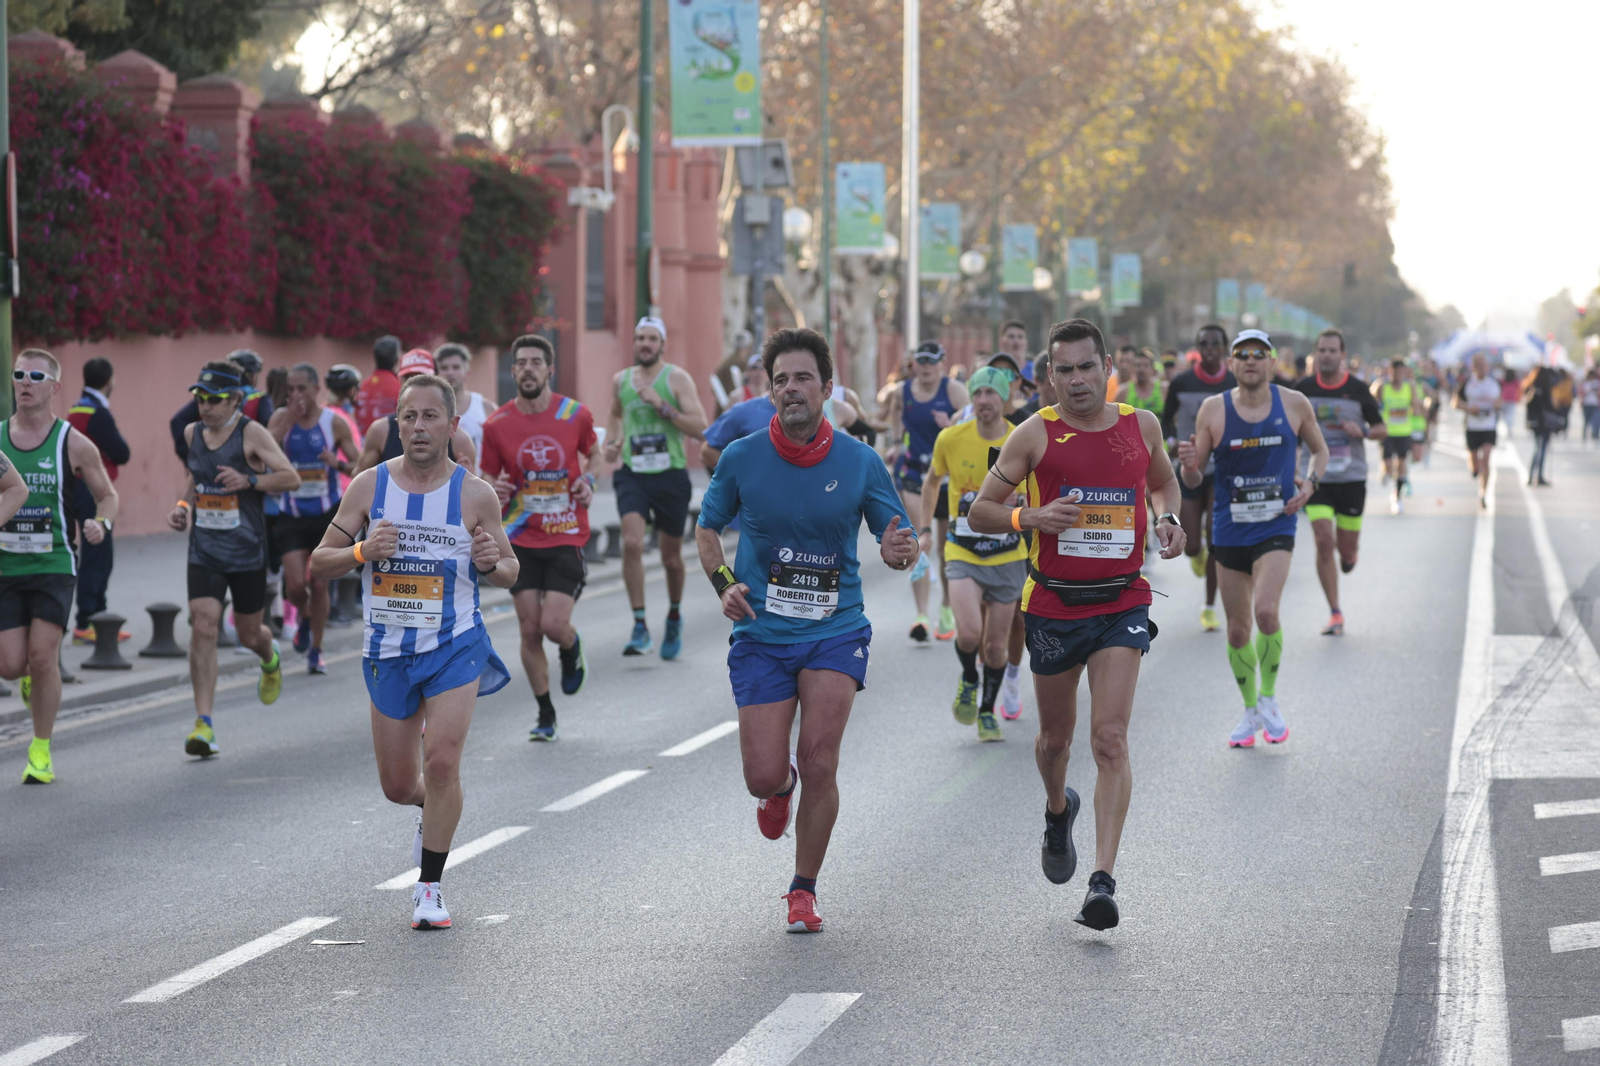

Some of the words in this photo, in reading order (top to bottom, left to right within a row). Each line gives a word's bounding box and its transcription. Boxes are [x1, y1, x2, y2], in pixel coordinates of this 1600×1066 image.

[1086, 492, 1128, 502] ZURICH
[1085, 513, 1112, 525] 3943
[16, 522, 34, 532] 1821
[415, 524, 446, 534] Deportiva
[418, 533, 457, 546] PAZITO
[1083, 531, 1112, 541] ISIDRO
[398, 543, 426, 553] Motril
[795, 552, 834, 565] ZURICH
[393, 562, 435, 573] ZURICH
[791, 573, 819, 587] 2419
[392, 583, 417, 594] 4889
[776, 588, 814, 603] ROBERTO
[816, 593, 830, 603] CID
[387, 599, 423, 610] GONZALO
